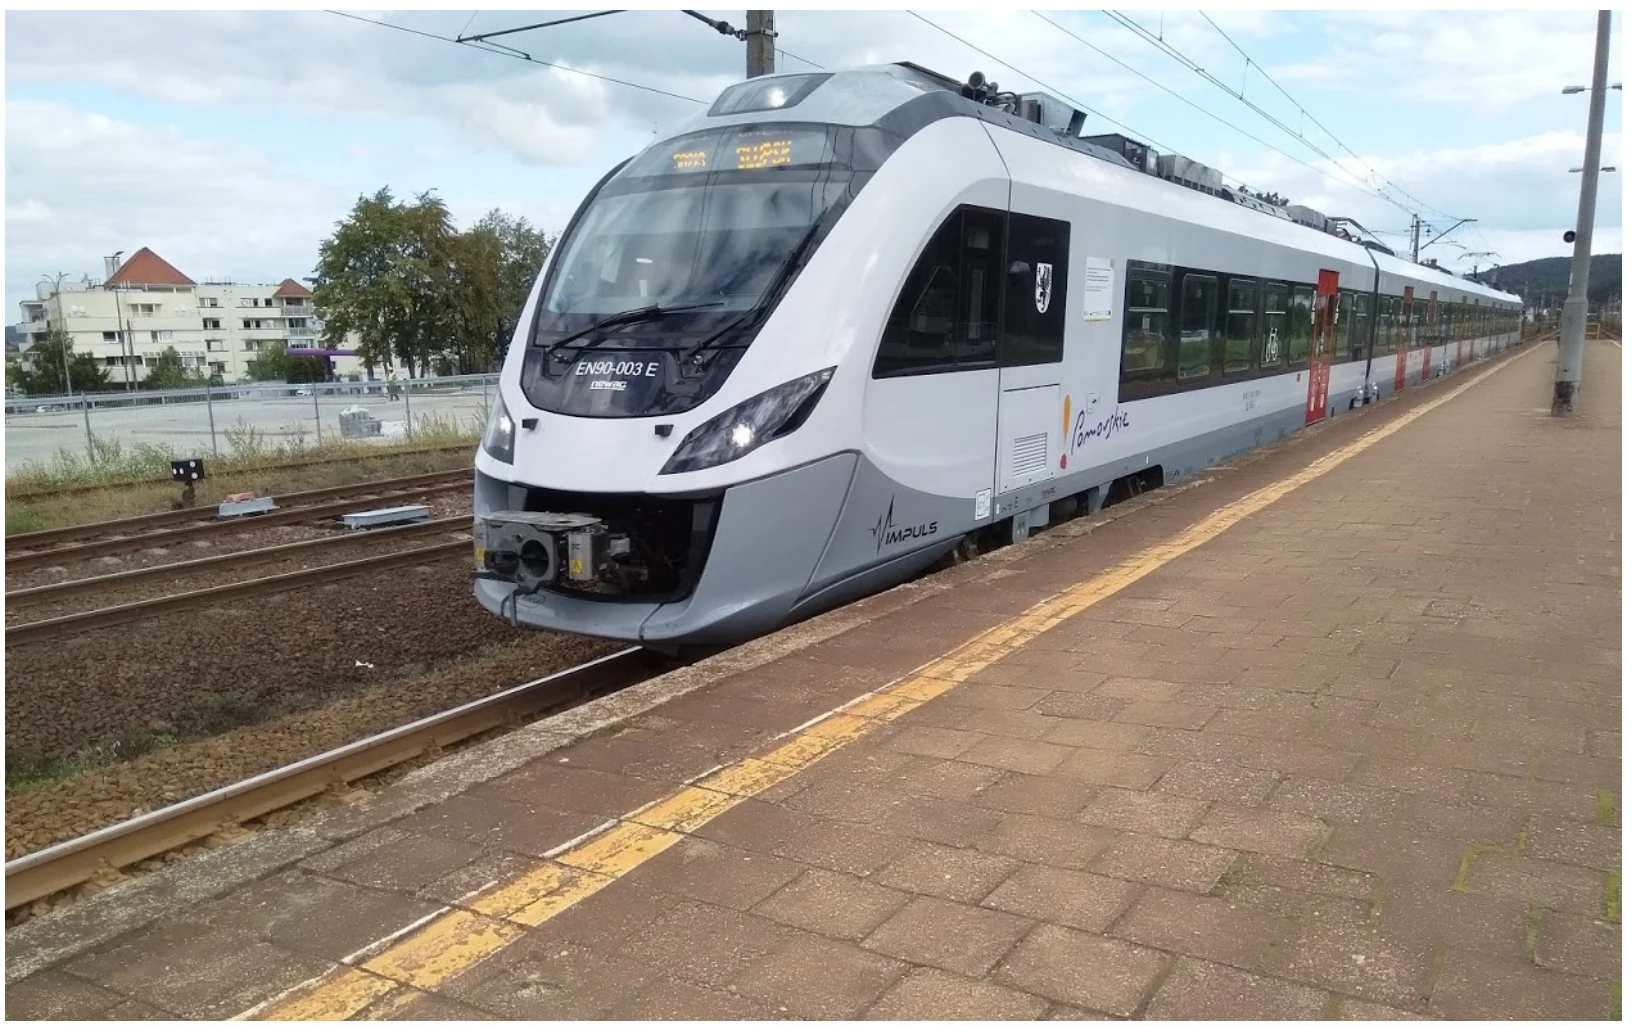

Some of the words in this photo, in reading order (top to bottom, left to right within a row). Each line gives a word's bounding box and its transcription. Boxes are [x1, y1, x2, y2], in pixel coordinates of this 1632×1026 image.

[575, 361, 643, 376] EN90-003
[645, 362, 659, 377] E
[1071, 405, 1130, 456] Pomorskie
[885, 520, 938, 545] IMPULS
